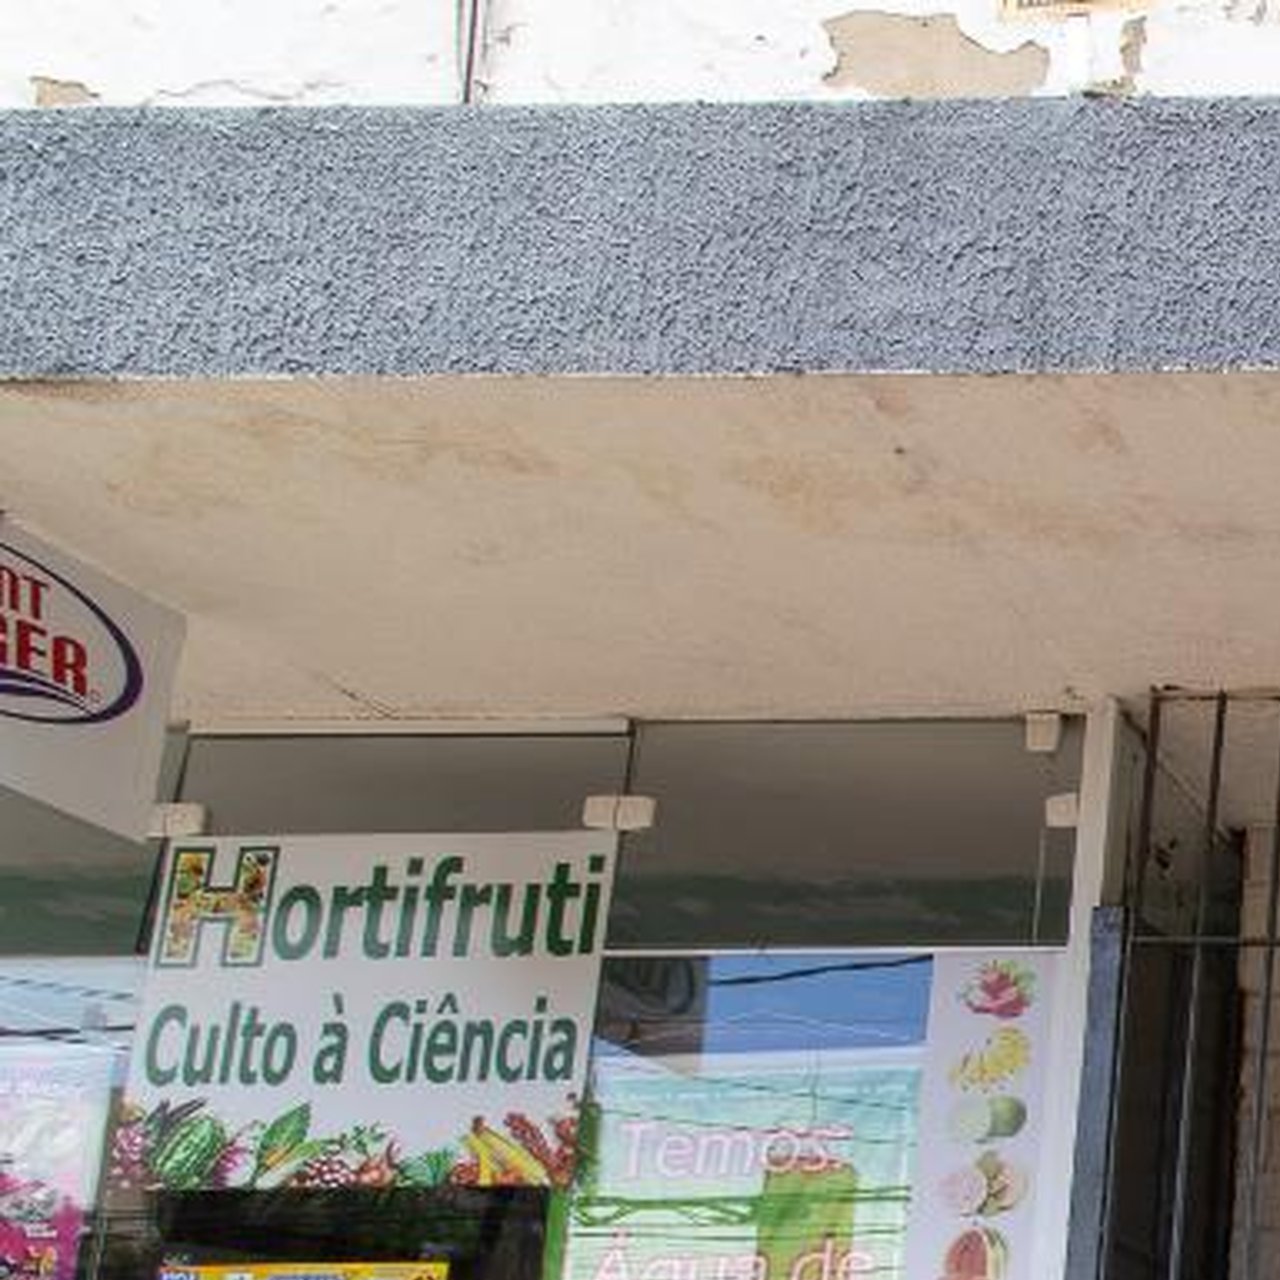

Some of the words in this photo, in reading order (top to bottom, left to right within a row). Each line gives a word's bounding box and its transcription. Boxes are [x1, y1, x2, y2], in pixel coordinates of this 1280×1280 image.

[154, 845, 608, 968] Hortifruti
[145, 1000, 299, 1088] Culto
[313, 993, 349, 1086] à
[367, 993, 578, 1086] Ciência
